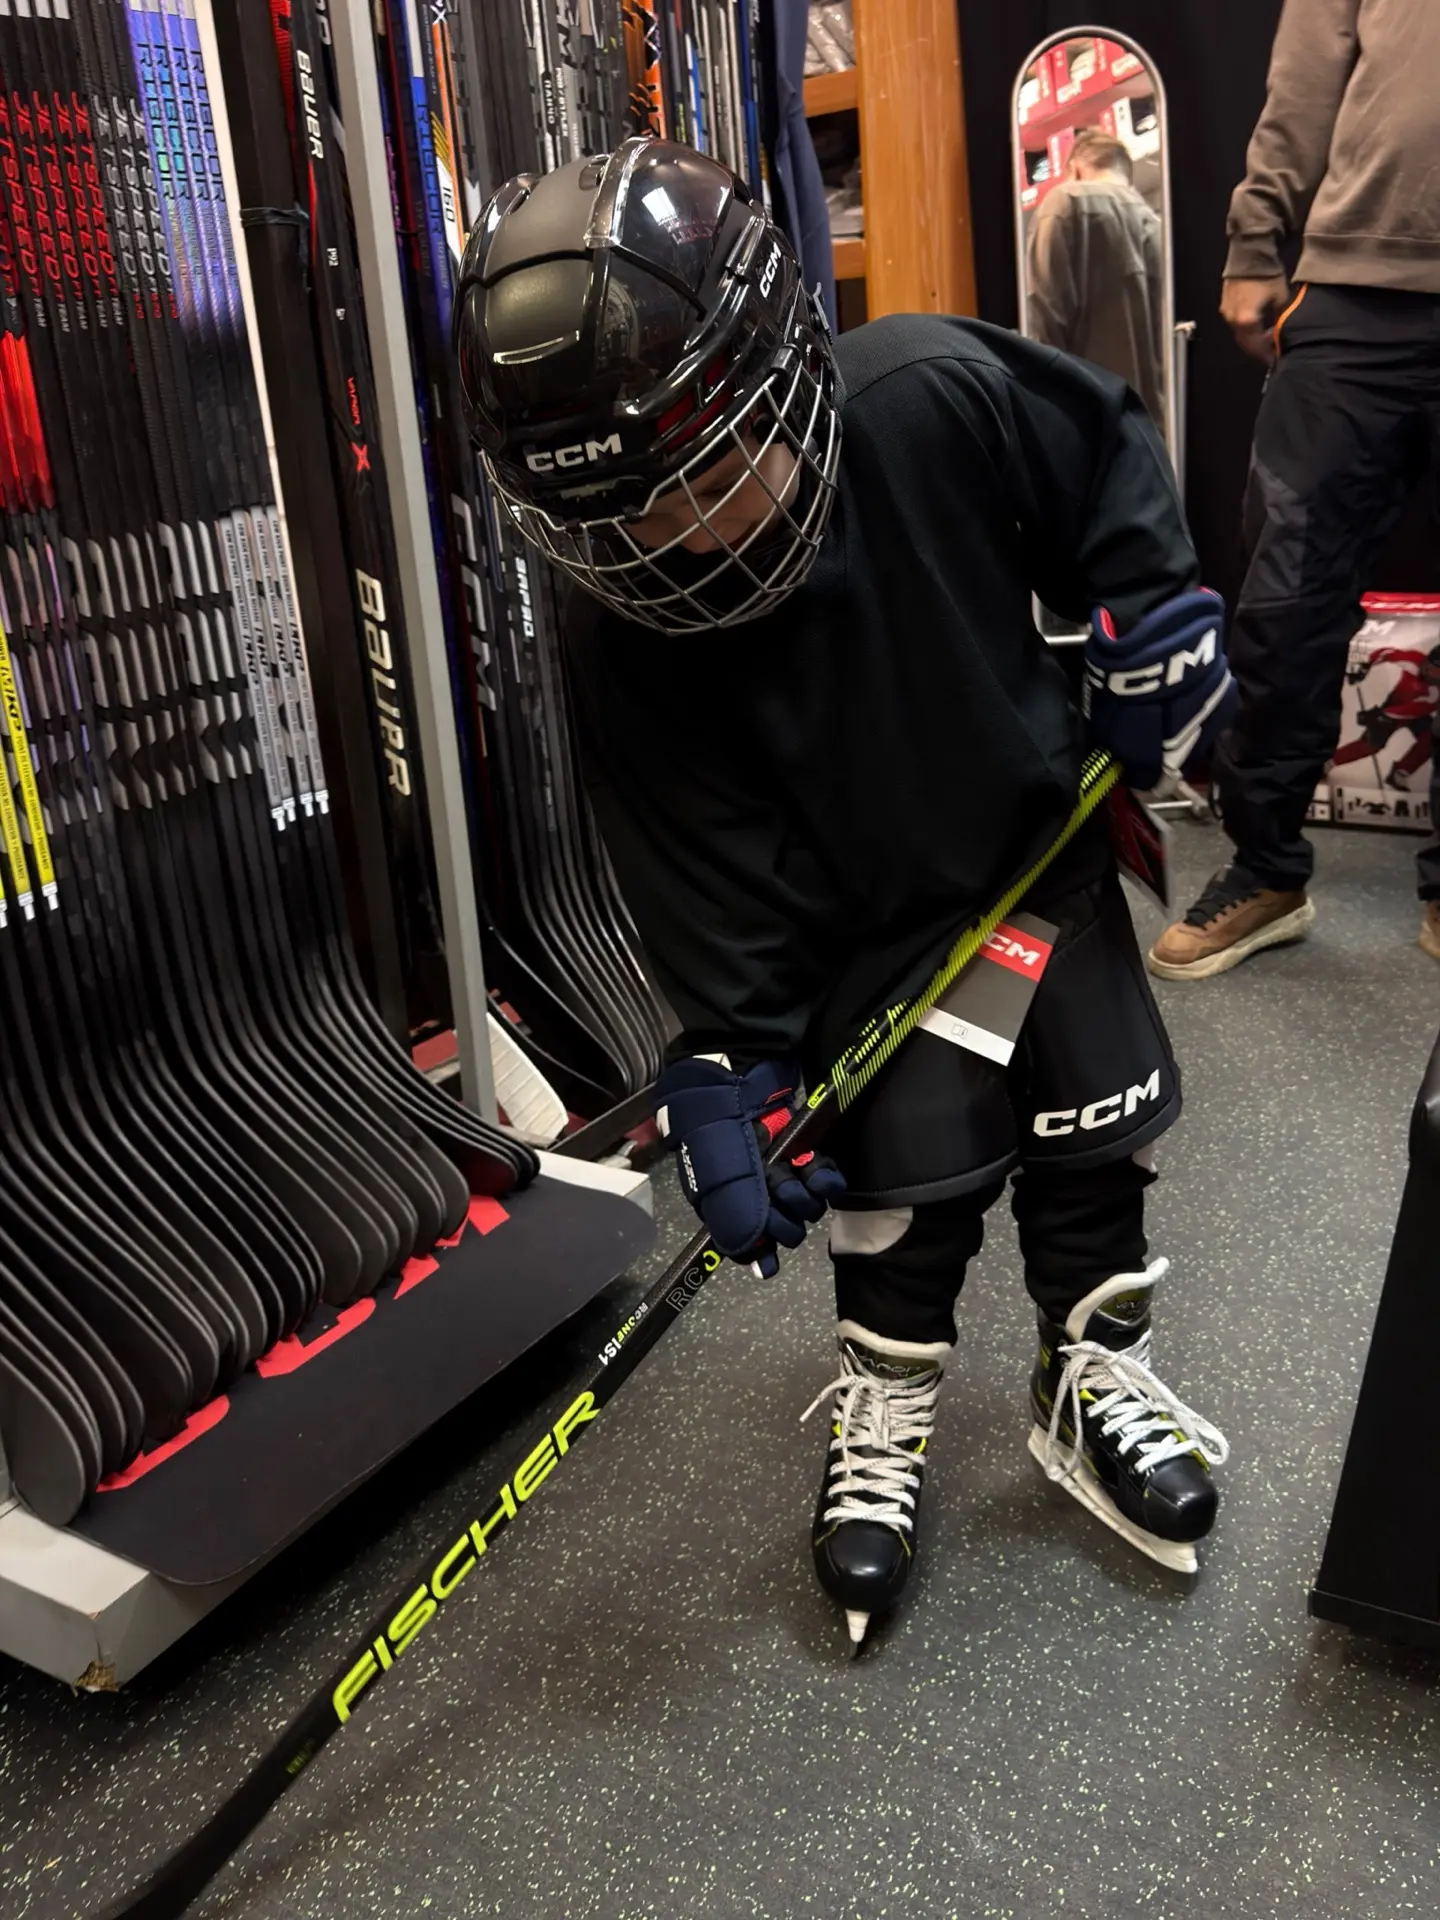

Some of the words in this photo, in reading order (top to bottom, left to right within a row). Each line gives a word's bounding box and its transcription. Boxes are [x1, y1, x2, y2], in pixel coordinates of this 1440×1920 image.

[12, 90, 60, 281] JETSPEED
[32, 90, 80, 279] JETSPEED
[52, 91, 99, 278] JETSPEED
[71, 91, 116, 276] JETSPEED
[93, 95, 138, 276] JETSPEED
[112, 96, 156, 276] JETSPEED
[129, 98, 172, 276] JETSPEED
[297, 50, 324, 159] BAUER
[416, 104, 443, 235] RIBCOR
[327, 247, 338, 267] P92
[442, 186, 456, 224] 160
[759, 242, 782, 299] CCM
[525, 432, 623, 472] CCM
[355, 567, 411, 797] BAUER
[985, 932, 1041, 967] CM
[1033, 1068, 1160, 1137] CCM
[333, 1391, 601, 1724] FISCHER
